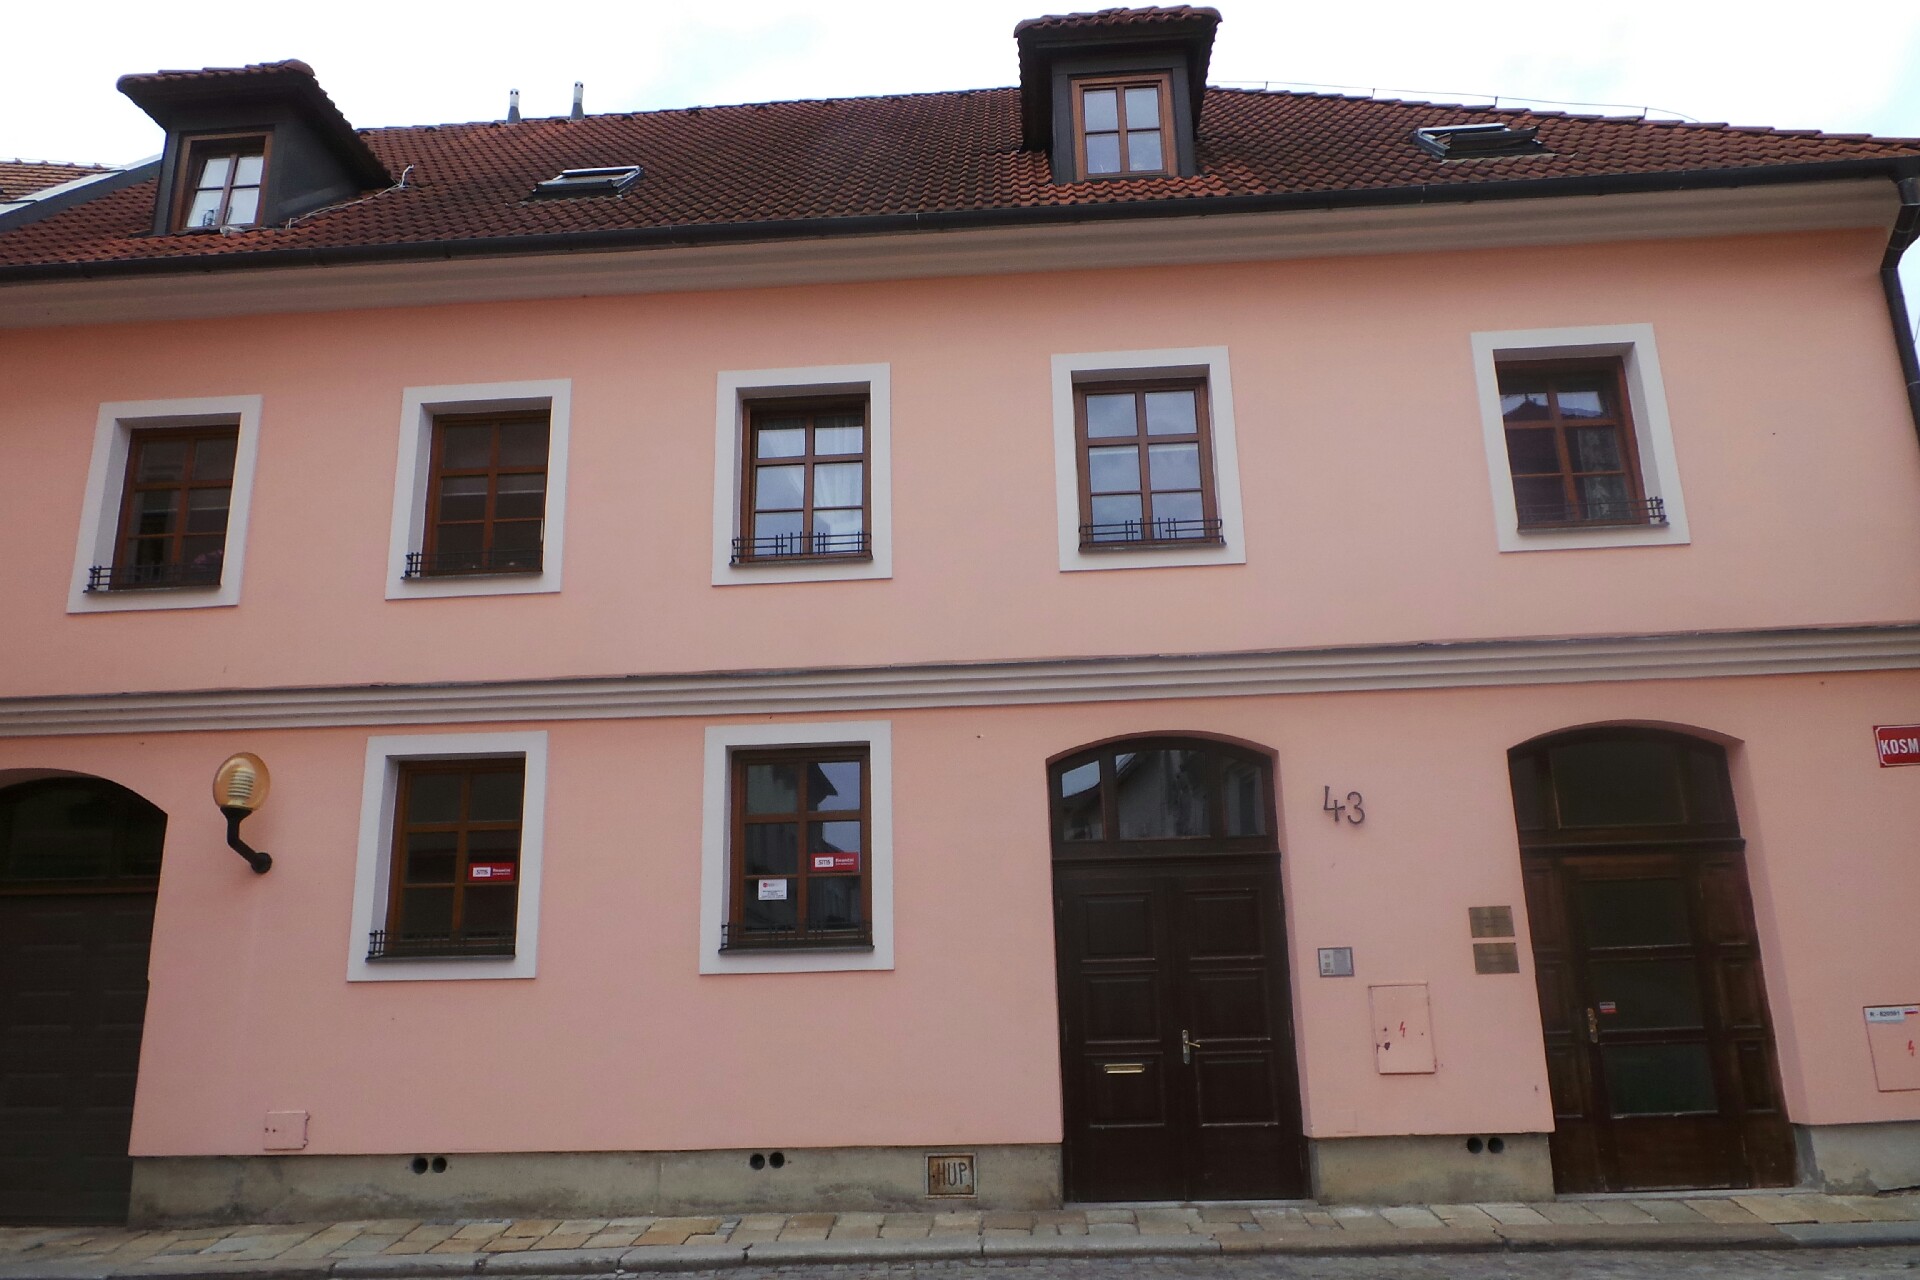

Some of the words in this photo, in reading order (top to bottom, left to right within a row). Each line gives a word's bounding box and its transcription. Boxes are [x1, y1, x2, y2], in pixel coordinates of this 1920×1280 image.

[1880, 738, 1919, 755] KOSM
[1323, 785, 1366, 825] 43
[937, 1162, 968, 1187] HUP
